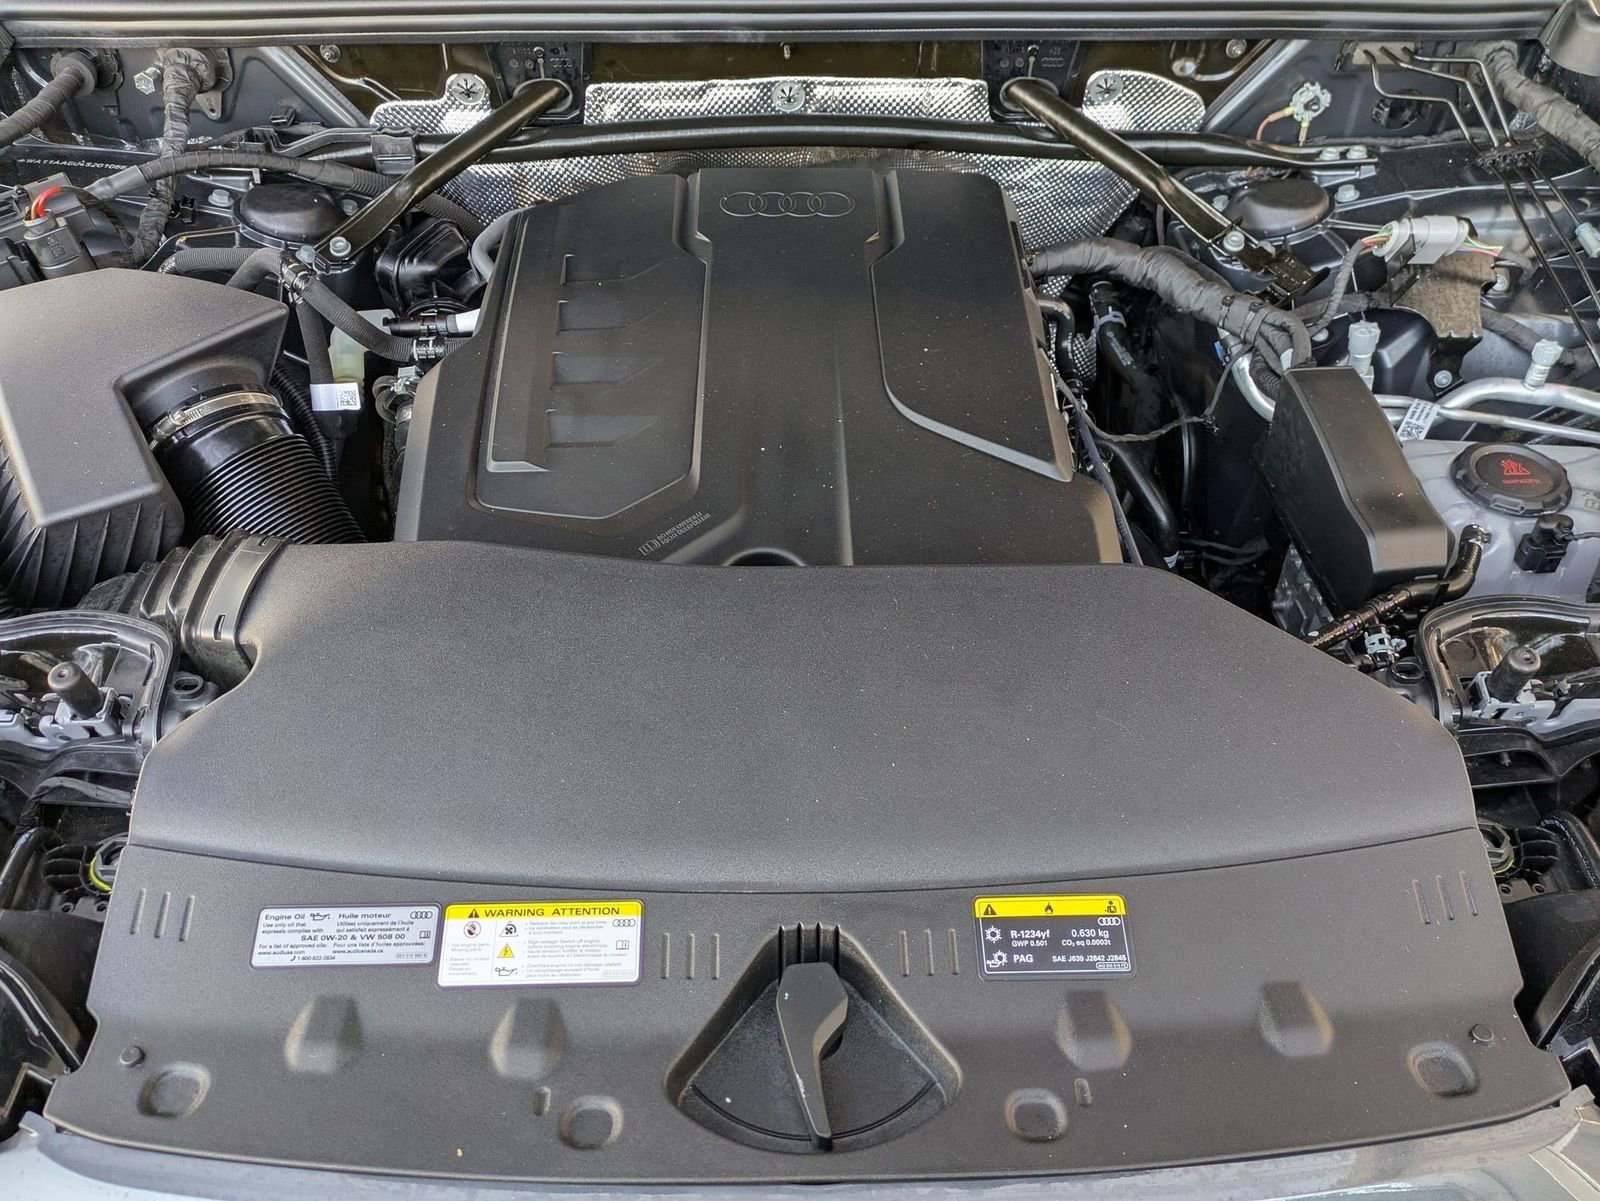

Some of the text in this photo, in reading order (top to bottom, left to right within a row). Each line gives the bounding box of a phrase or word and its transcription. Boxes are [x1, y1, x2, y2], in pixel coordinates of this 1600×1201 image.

[484, 907, 620, 917] WARNING ATTENTION
[1010, 929, 1109, 940] R-1234yf 0.630 kg
[1013, 954, 1034, 963] PAG
